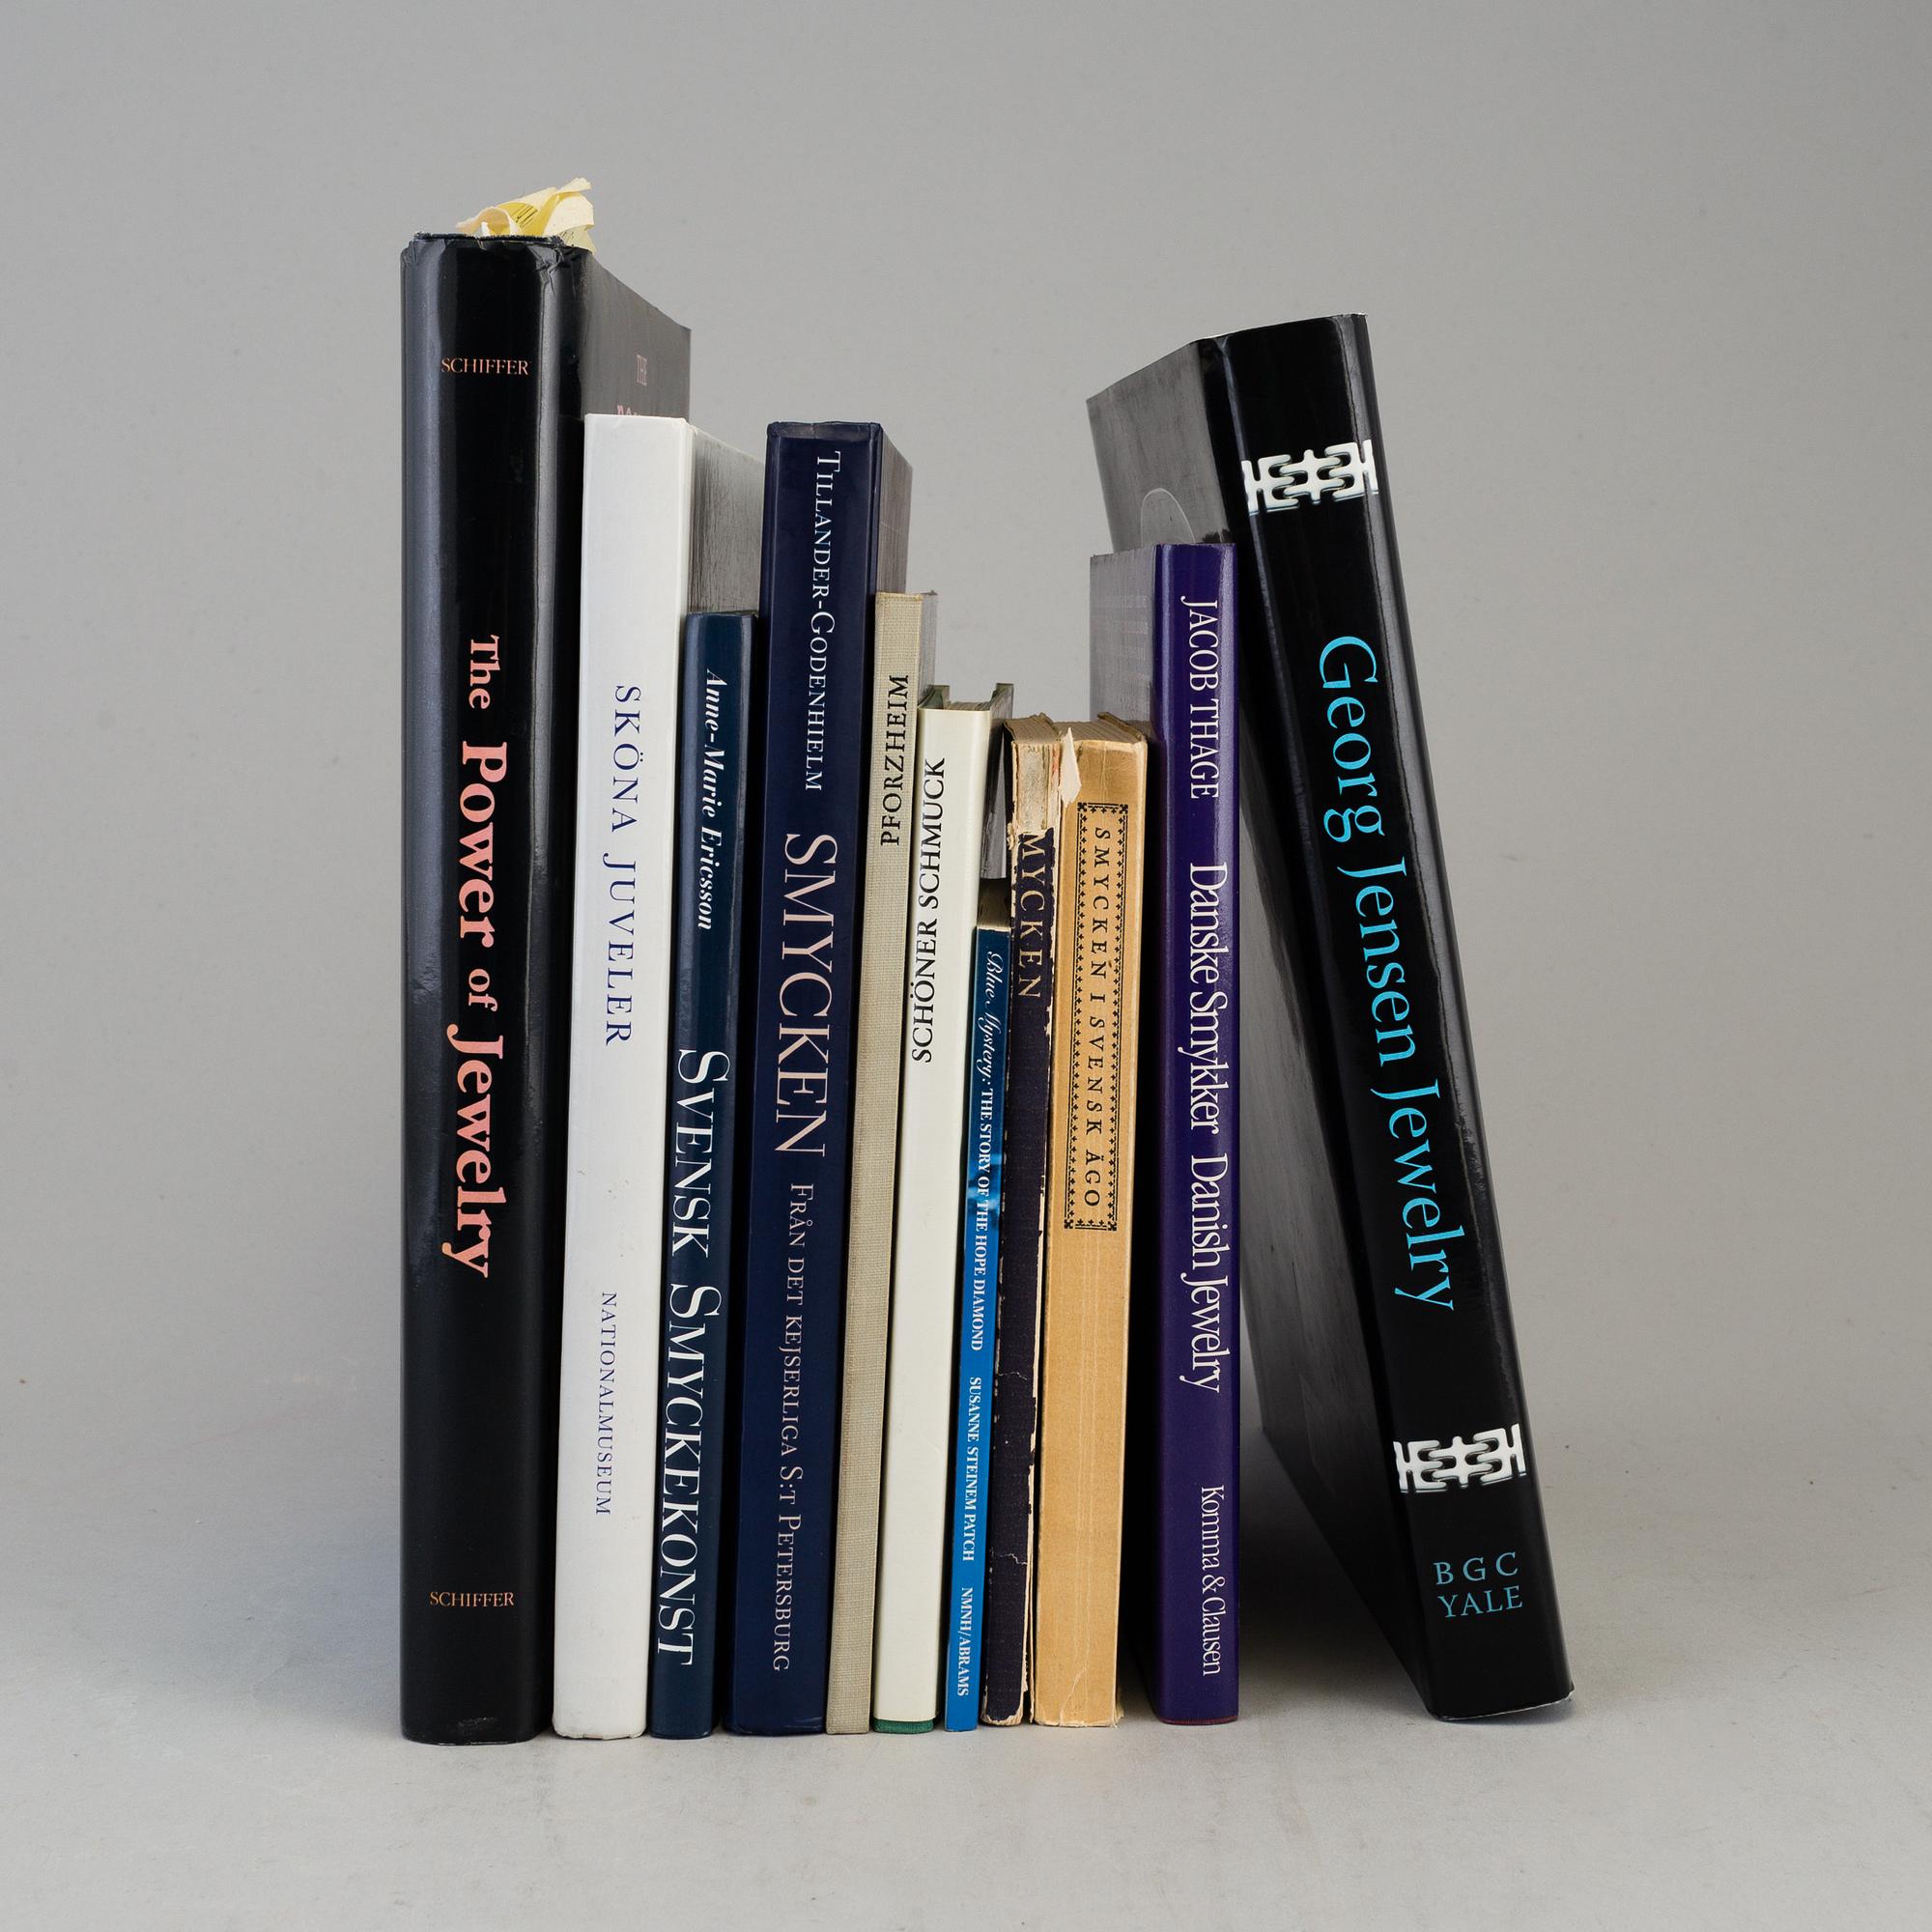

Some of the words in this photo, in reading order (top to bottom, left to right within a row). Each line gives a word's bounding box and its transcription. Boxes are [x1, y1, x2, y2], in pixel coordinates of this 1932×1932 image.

[440, 356, 529, 376] SCHIFFER
[469, 635, 499, 708] The
[1180, 595, 1219, 692] JACOB
[612, 686, 643, 832] SKÖNA
[701, 668, 727, 818] Anne-Marie
[880, 675, 909, 846] PFORZHEIM
[1189, 698, 1219, 800] THAGE
[1319, 636, 1385, 843] Georg
[459, 741, 507, 947] Power
[697, 826, 723, 930] Ericsson
[918, 757, 946, 909] SCHMUCK
[603, 853, 636, 1045] JUVELER
[1090, 826, 1112, 980] SMYCKEN
[1189, 863, 1229, 984] Danske
[469, 969, 497, 1011] of
[775, 833, 838, 1157] SMYCKEN
[910, 919, 937, 1063] SCHÖNER
[985, 951, 1004, 998] Blue
[1090, 992, 1106, 1004] I
[1337, 856, 1417, 1067] Jensen
[976, 1000, 1001, 1086] Mystery:
[1086, 1015, 1105, 1136] SVENSK
[1178, 992, 1229, 1134] Smykker
[442, 1024, 506, 1277] Jewelry
[978, 1122, 992, 1173] STORY
[980, 1088, 994, 1121] THE
[976, 1176, 990, 1198] OF
[976, 1199, 991, 1233] THE
[1084, 1149, 1105, 1207] ÄGO
[1192, 1153, 1230, 1269] Danish
[1371, 1078, 1465, 1310] Jewelry
[786, 1258, 805, 1306] DET
[974, 1235, 987, 1276] HOPE
[971, 1279, 986, 1351] DIAMOND
[1179, 1273, 1230, 1393] Jewelry
[595, 1293, 617, 1514] NATIONALMUSEUM
[779, 1315, 803, 1457] KEJSERLIGA
[967, 1377, 982, 1442] SUSANNE
[964, 1446, 980, 1510] STEINEM
[962, 1514, 977, 1561] PATCH
[1201, 1485, 1225, 1571] Komma
[430, 1591, 514, 1607] SCHIFFER
[1202, 1574, 1226, 1595] &
[1436, 1584, 1523, 1618] YALE
[956, 1587, 974, 1696] NMNH/ABRAMS
[1201, 1597, 1227, 1677] Clausen
